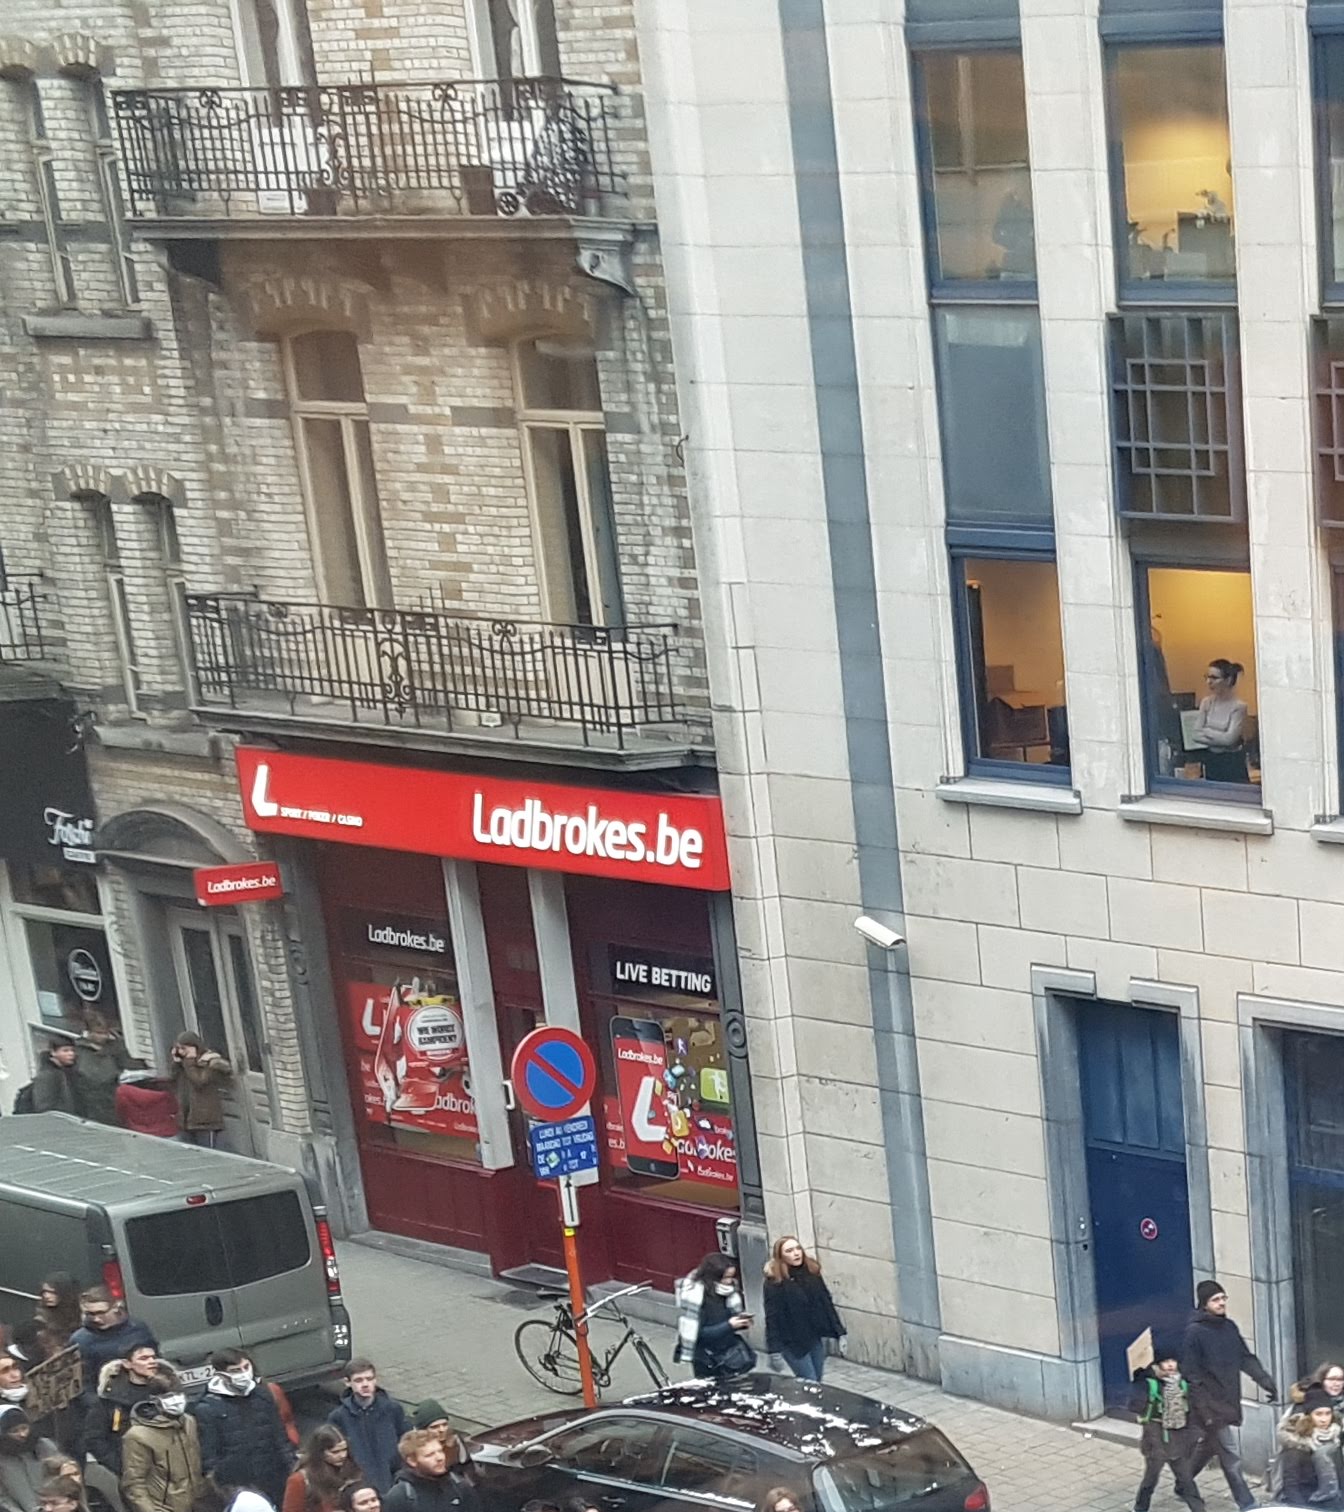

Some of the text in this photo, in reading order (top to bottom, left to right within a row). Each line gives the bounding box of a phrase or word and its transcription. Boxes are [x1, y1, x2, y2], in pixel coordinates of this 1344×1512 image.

[472, 793, 703, 868] Ladbrokes.be
[207, 875, 276, 893] Ladbrokes.be
[368, 924, 444, 952] Ladbrokes.be
[616, 961, 711, 992] LIVE BETTING
